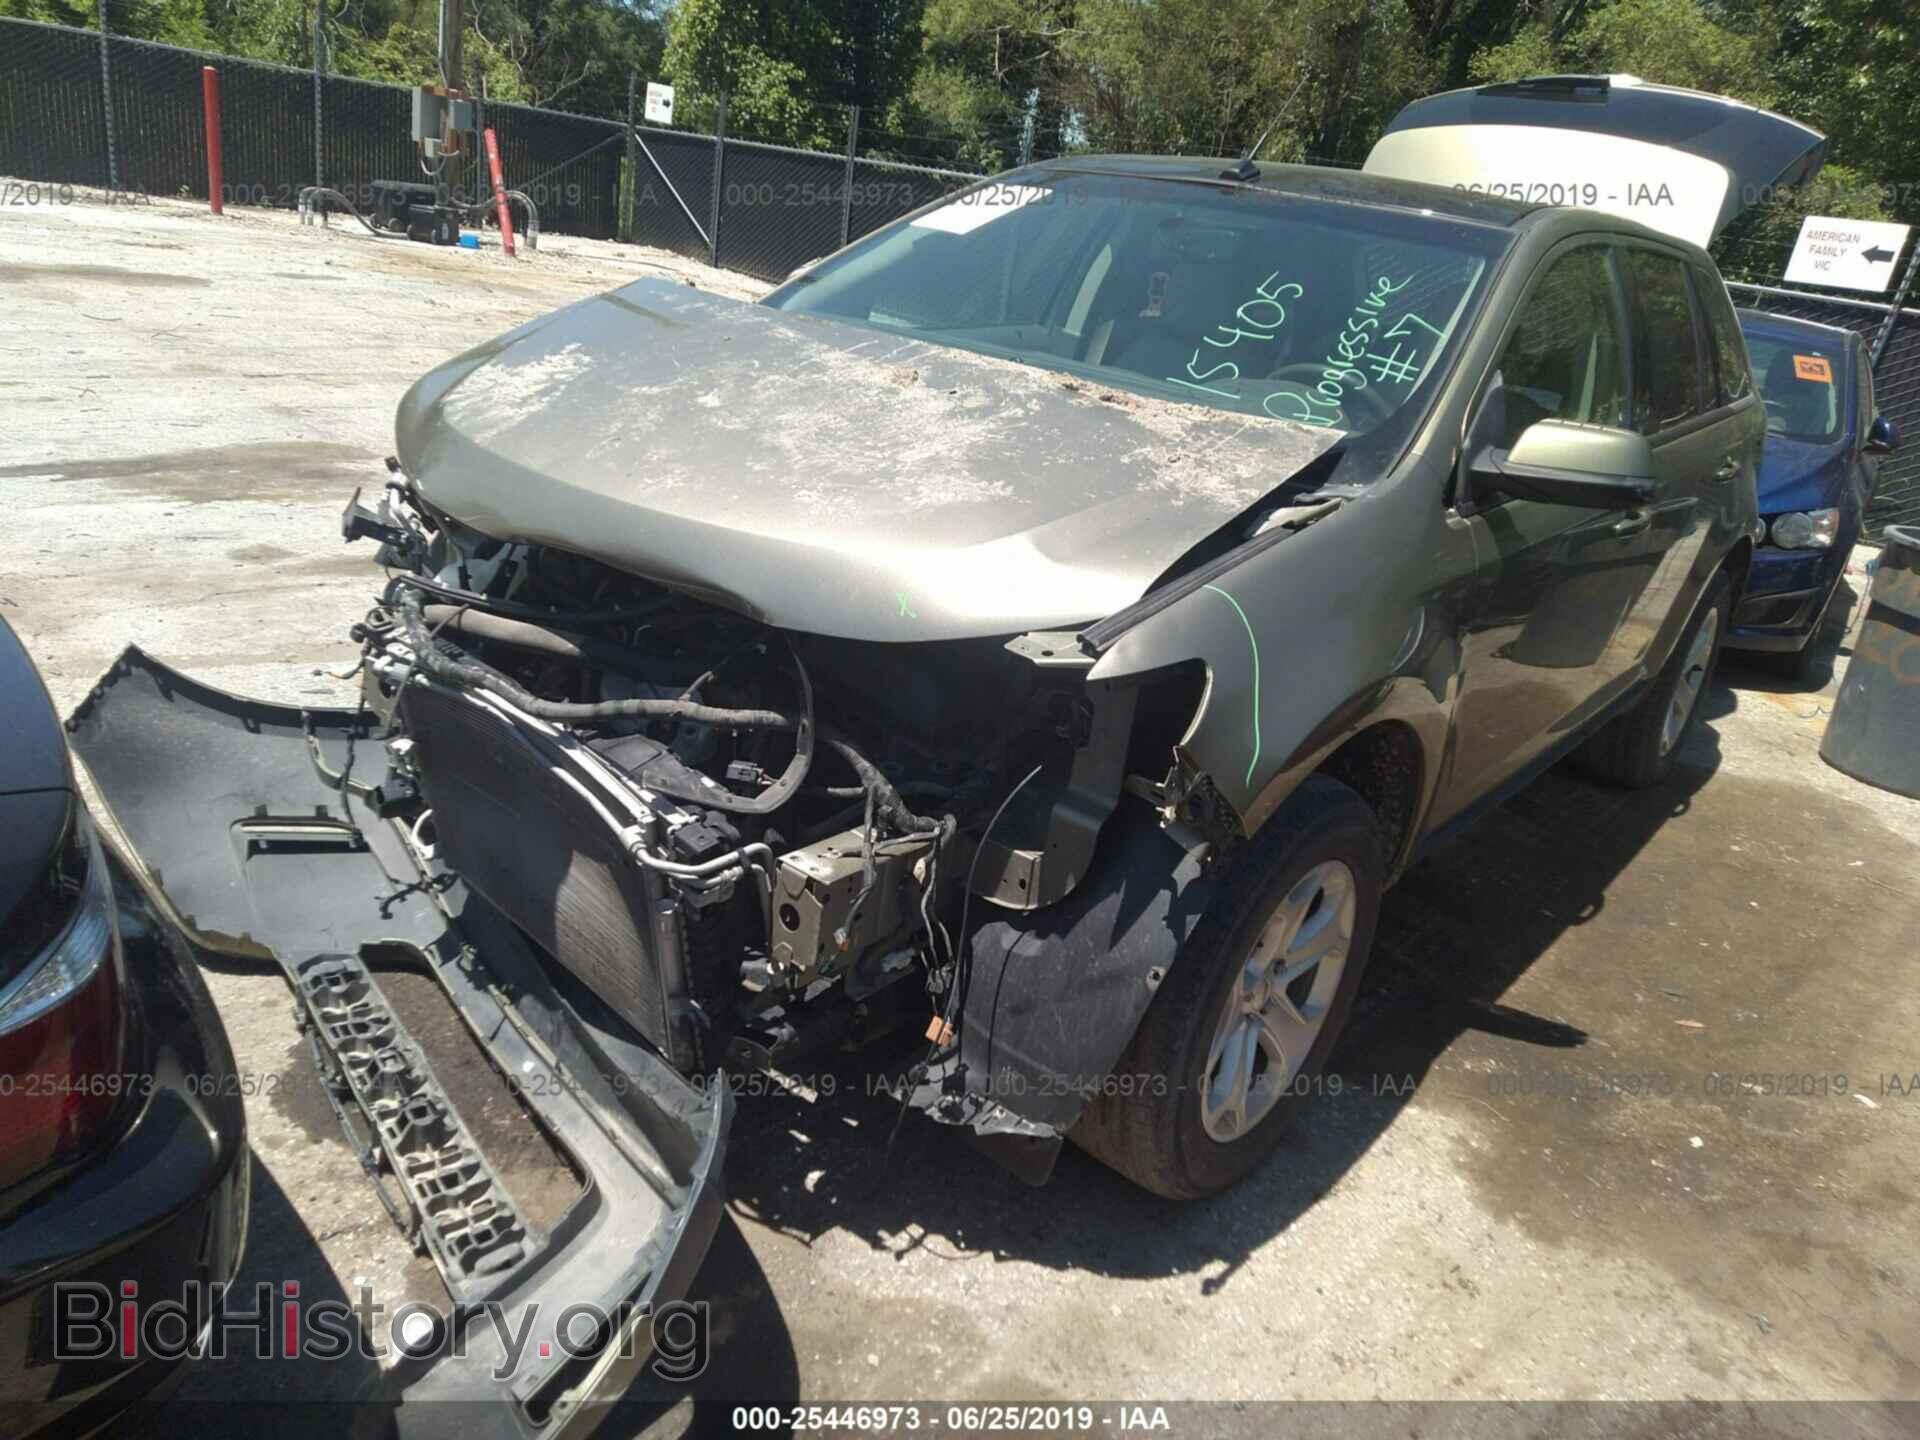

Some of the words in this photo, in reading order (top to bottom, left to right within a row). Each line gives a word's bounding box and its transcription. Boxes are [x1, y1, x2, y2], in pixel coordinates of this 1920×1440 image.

[1806, 229, 1861, 243] AMERICAN
[1808, 244, 1848, 257] FAMILY
[1166, 271, 1303, 400] 15405
